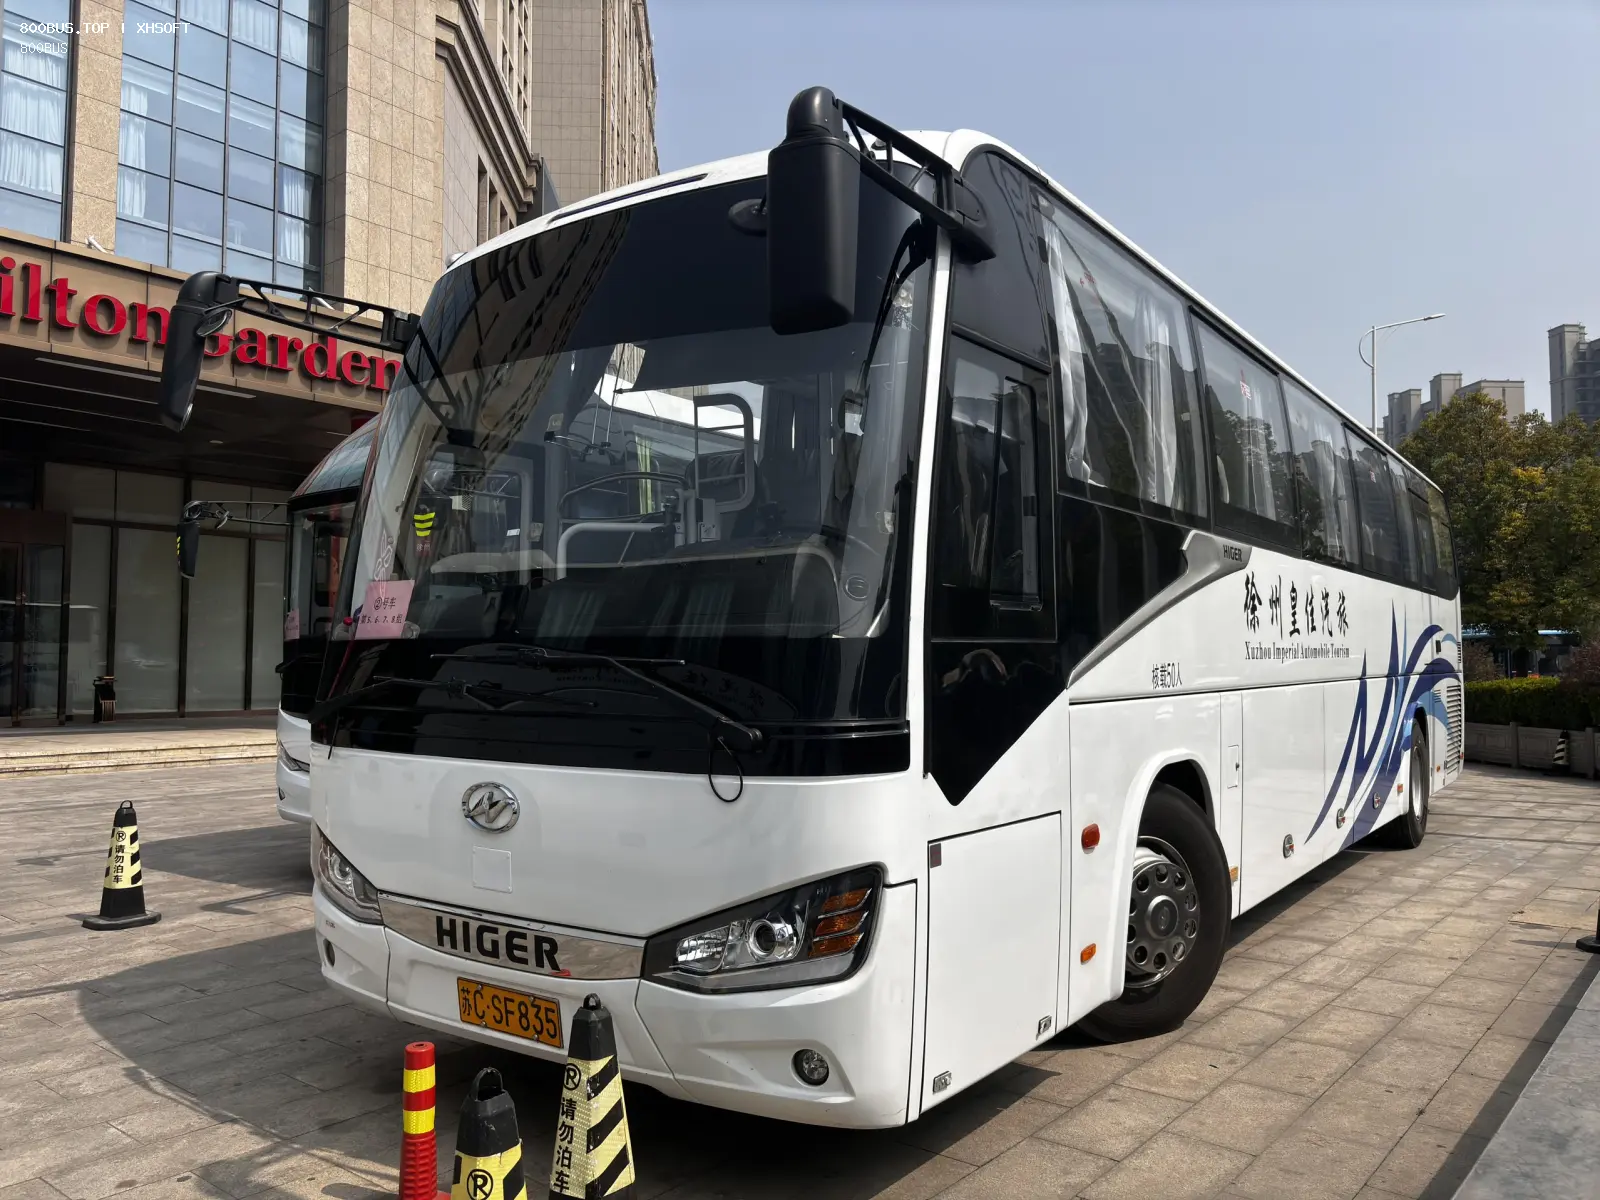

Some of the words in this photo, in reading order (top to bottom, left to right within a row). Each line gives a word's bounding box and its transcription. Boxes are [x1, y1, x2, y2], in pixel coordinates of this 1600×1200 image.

[1222, 544, 1243, 562] HIGER
[1245, 641, 1272, 660] Xuzhou
[1273, 641, 1299, 664] Imperial
[1300, 642, 1330, 659] Automobile
[1330, 643, 1350, 659] Tourism
[1151, 662, 1183, 690] 核载50人
[113, 845, 125, 884] 请勿泊车
[436, 915, 562, 972] HIGER
[553, 1096, 577, 1194] 请勿泊车
